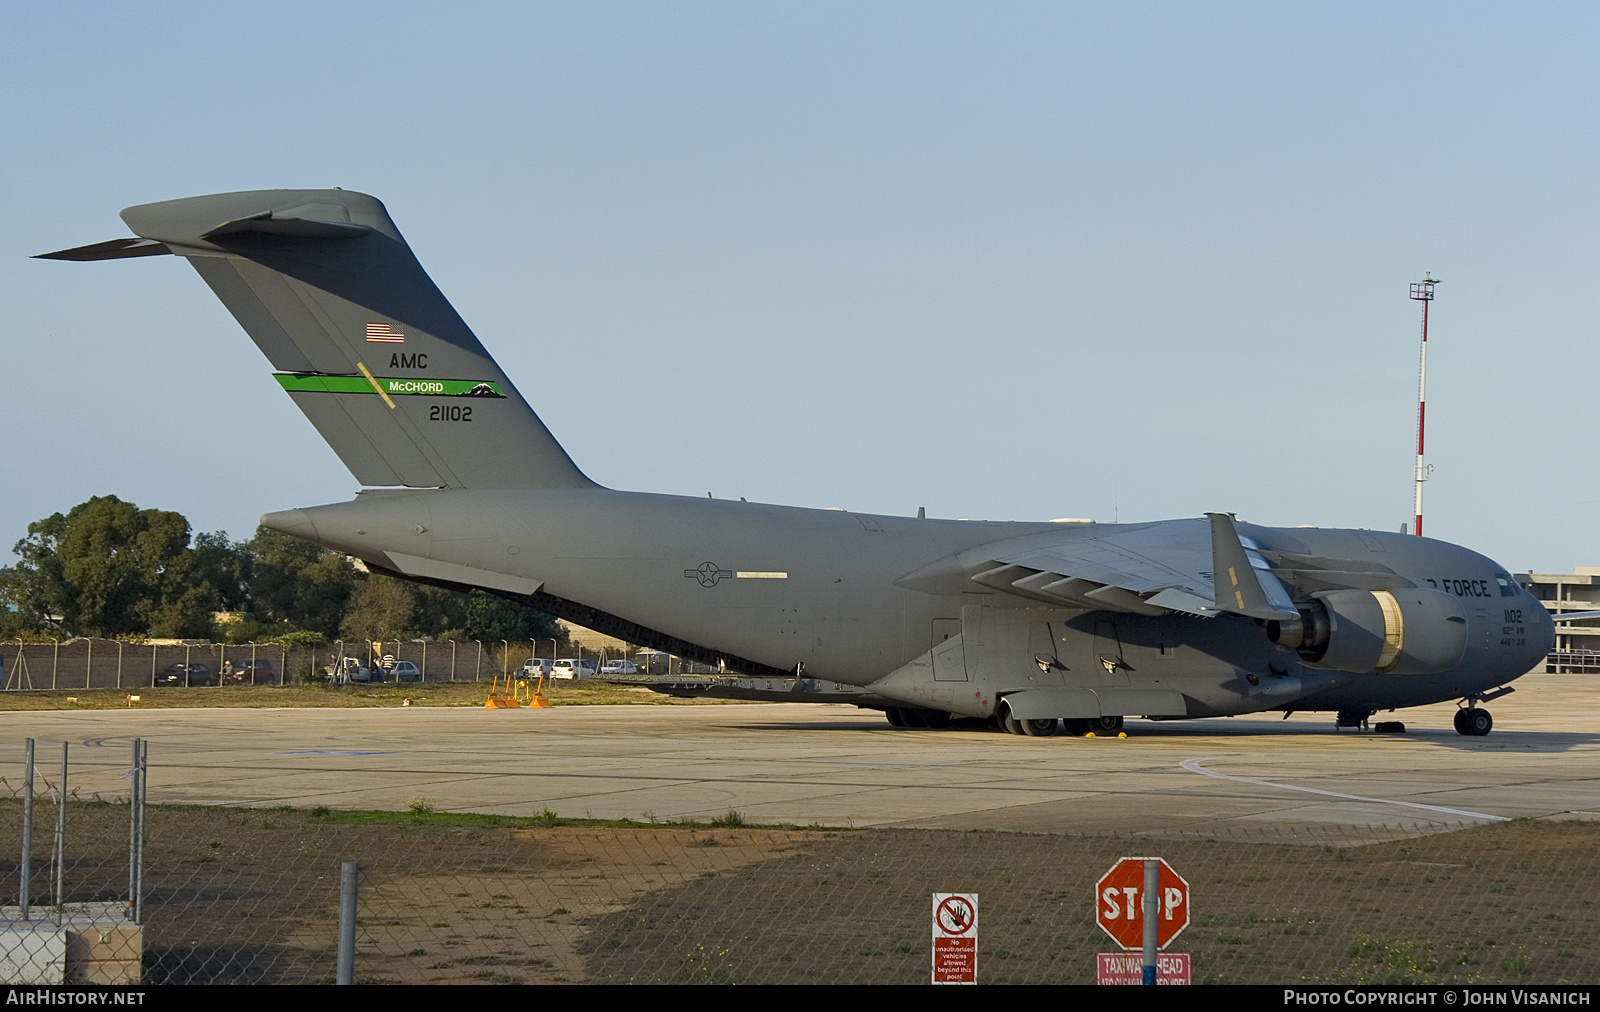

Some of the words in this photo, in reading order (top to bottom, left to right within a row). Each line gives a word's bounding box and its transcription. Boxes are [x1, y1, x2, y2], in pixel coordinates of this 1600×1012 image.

[390, 353, 428, 369] AMC
[389, 381, 444, 393] McCHORD
[429, 405, 473, 422] 21102
[1442, 579, 1492, 597] FORCE
[1504, 609, 1523, 624] 1102
[1102, 887, 1183, 920] STP
[937, 966, 960, 974] beyond
